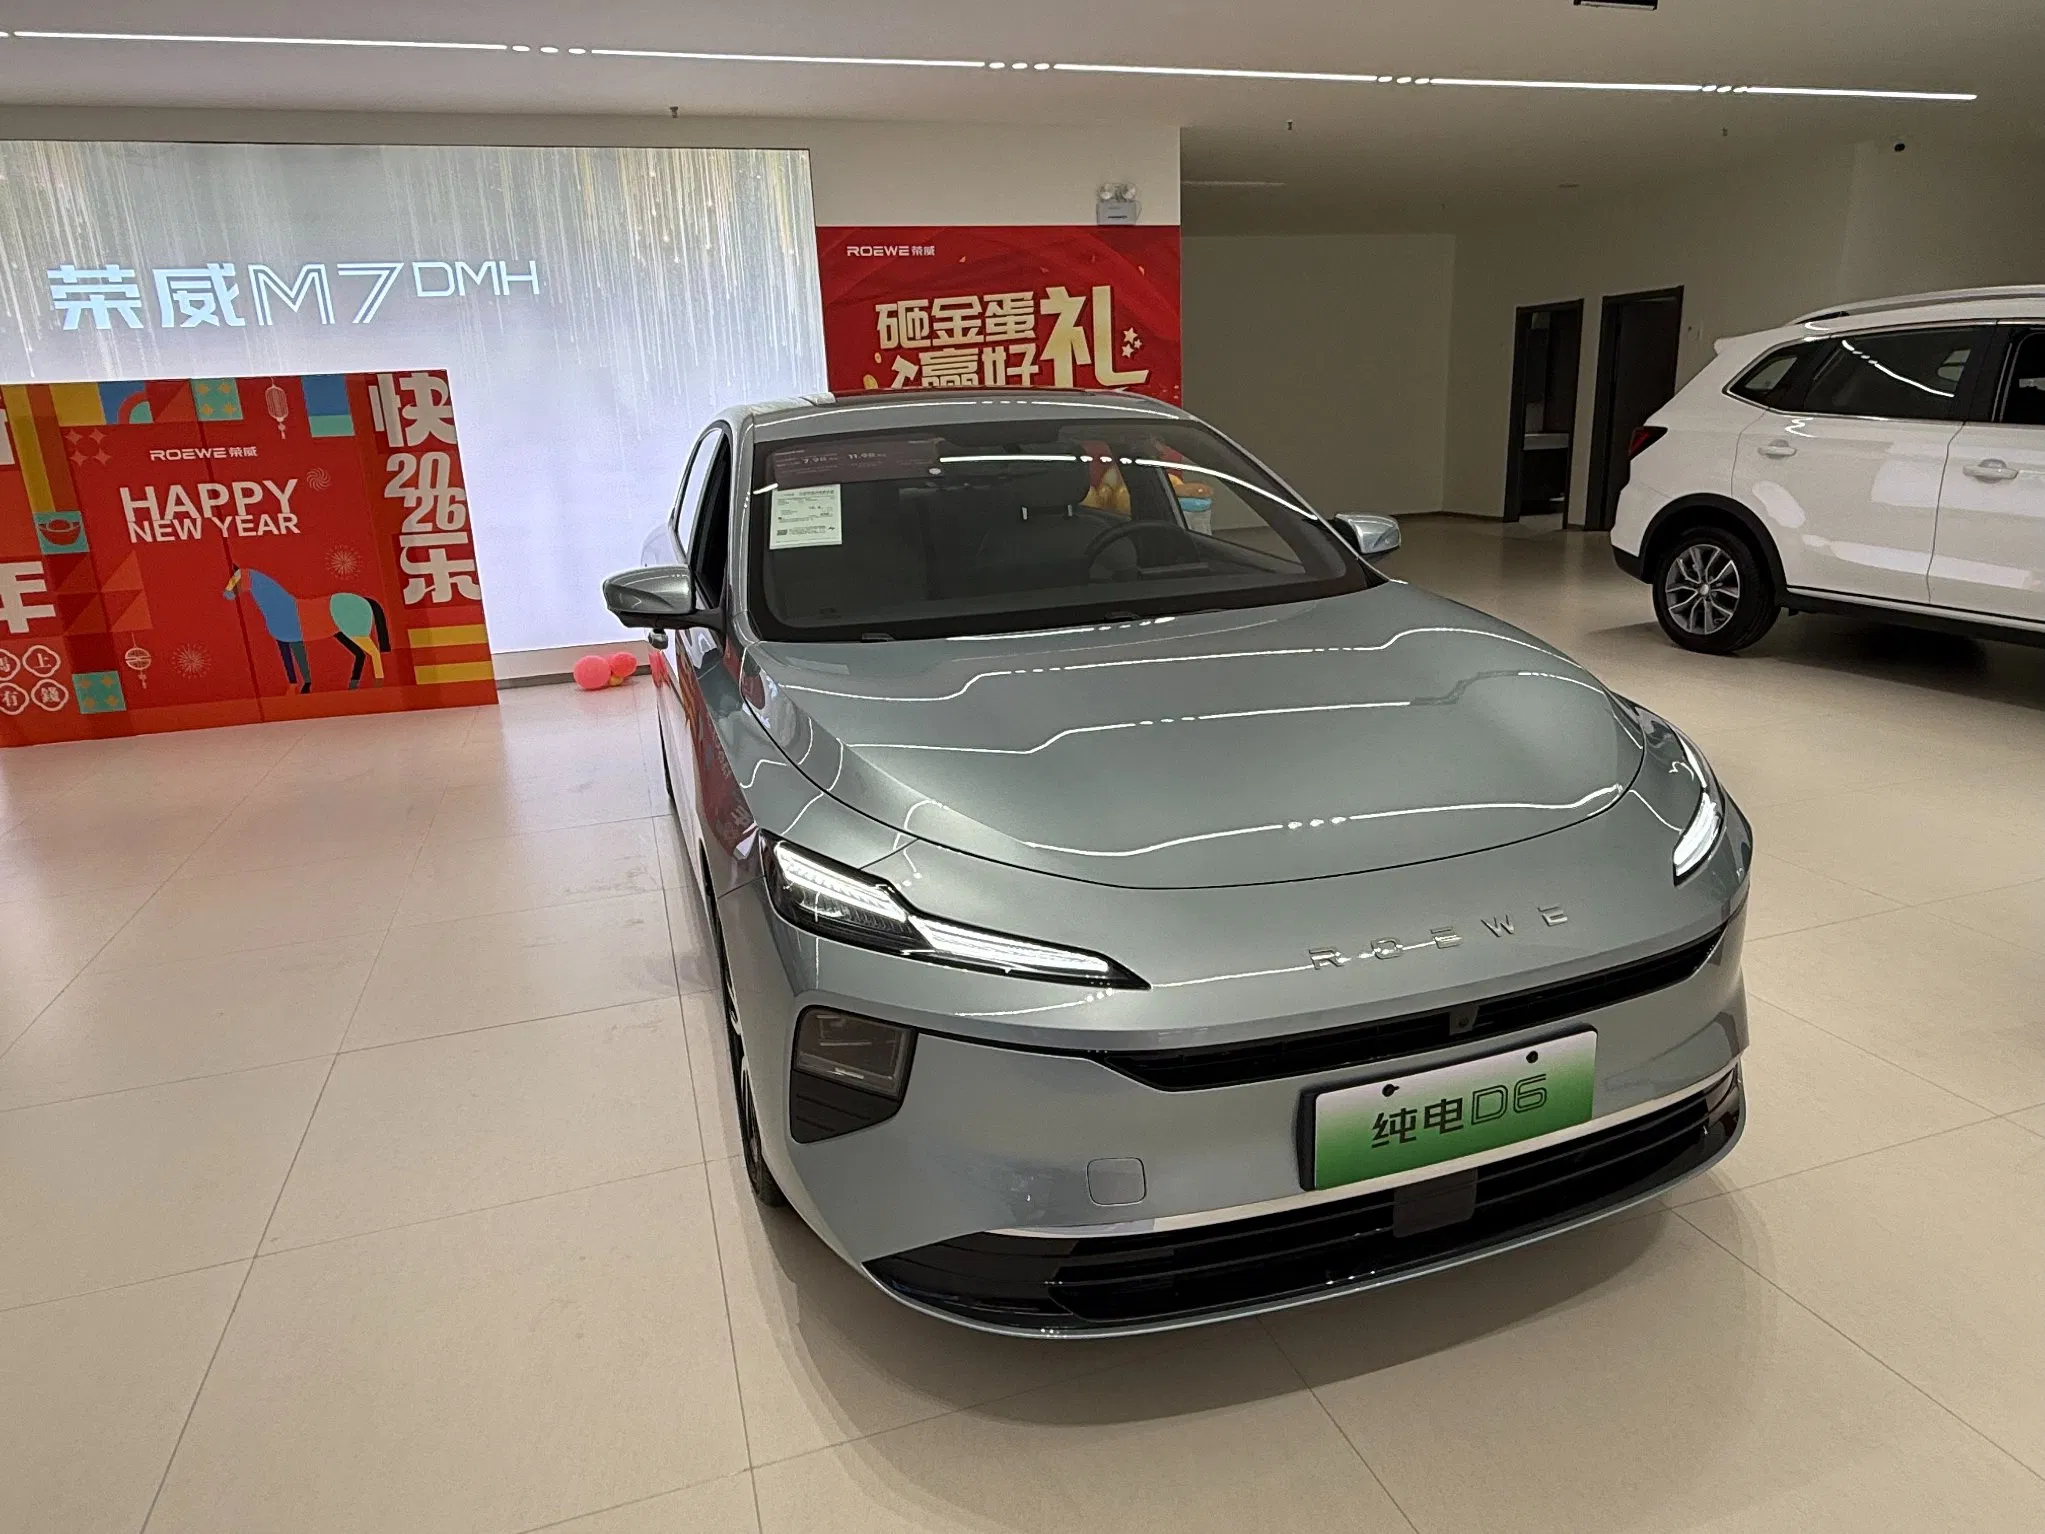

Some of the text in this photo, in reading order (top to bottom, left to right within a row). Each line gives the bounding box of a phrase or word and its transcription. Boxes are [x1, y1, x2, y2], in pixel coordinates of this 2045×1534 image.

[847, 245, 935, 257] ROEWE 荣威
[875, 291, 1036, 349] 砸金蛋
[368, 372, 459, 447] 快
[150, 446, 258, 461] ROEWE 荣威
[119, 478, 298, 522] HAPPY
[128, 512, 300, 543] NEW YEAR
[1308, 903, 1568, 971] ROEWE
